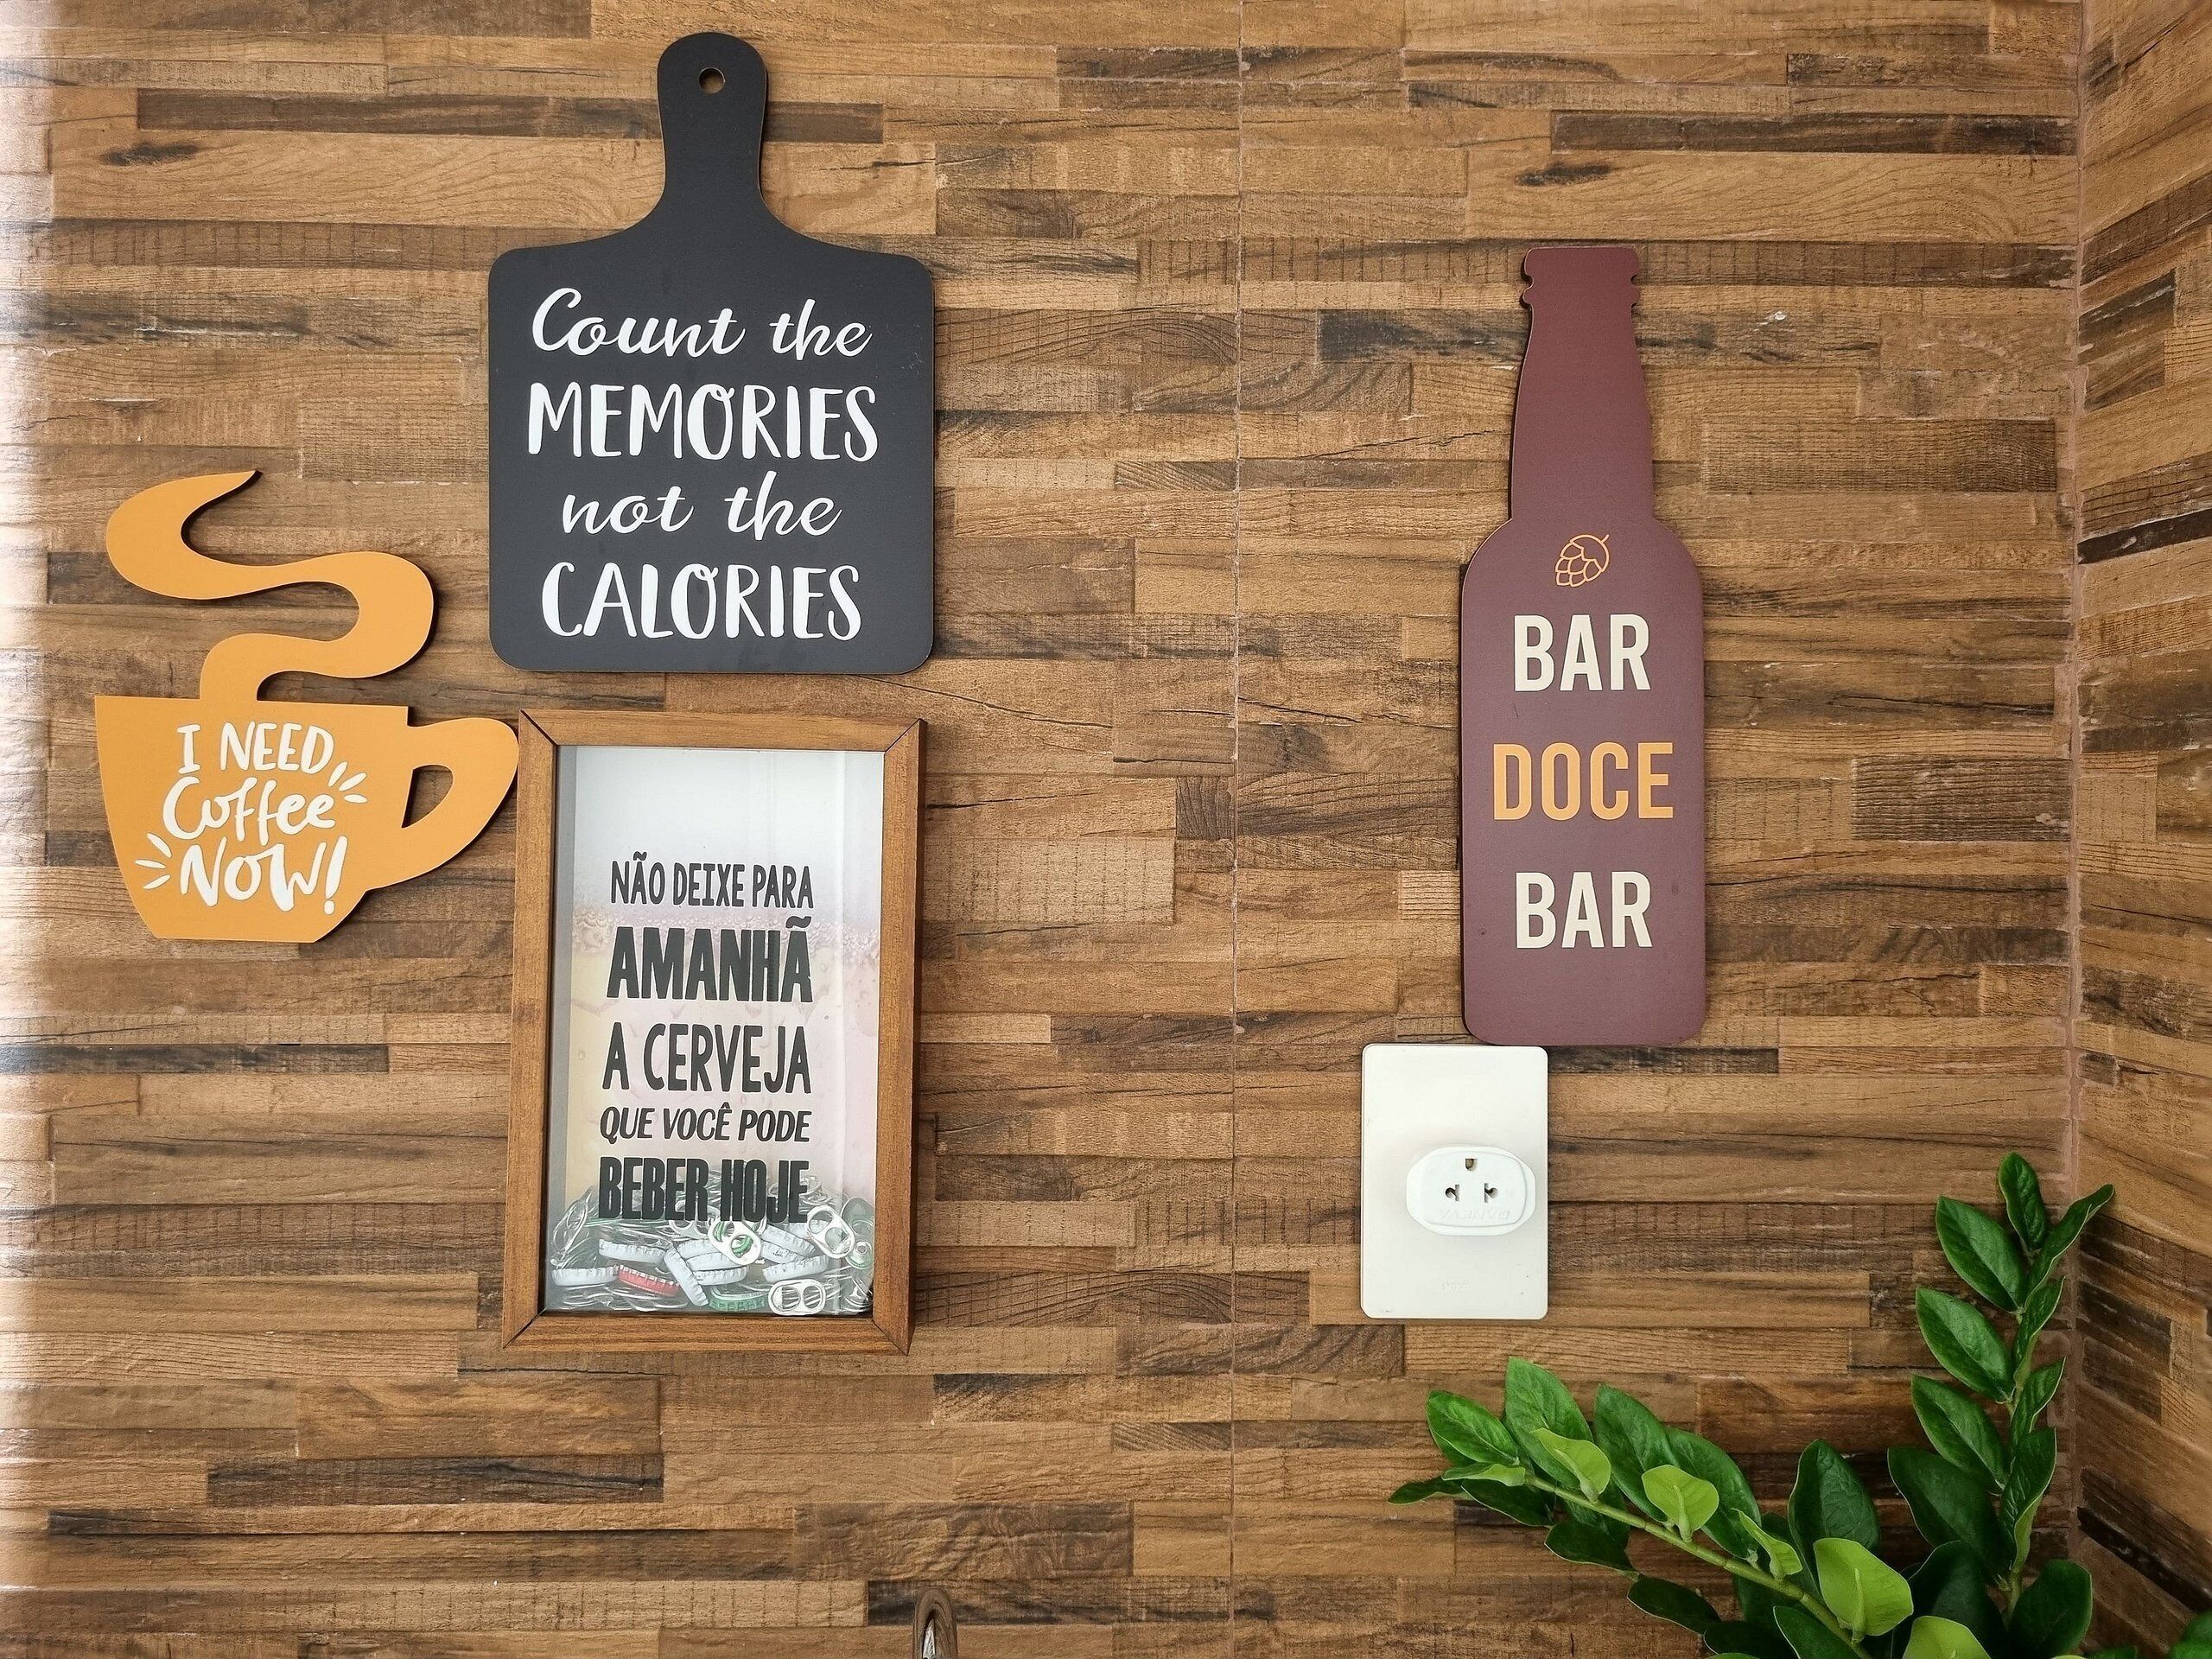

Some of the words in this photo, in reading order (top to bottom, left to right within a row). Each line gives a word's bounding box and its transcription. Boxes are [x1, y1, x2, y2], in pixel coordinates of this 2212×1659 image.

[532, 288, 745, 357] Count
[770, 299, 872, 360] the
[529, 382, 877, 461] MEMORIES
[563, 486, 694, 534] not
[724, 471, 842, 540] the
[543, 563, 861, 640] CALORIES
[1515, 614, 1650, 691] BAR
[177, 725, 200, 773] I
[220, 721, 334, 773] NEED
[1494, 742, 1673, 820] DOCE
[162, 776, 336, 846] Coffee
[180, 836, 348, 915] NOW!
[612, 851, 664, 904] NÃO
[673, 863, 745, 906] DEIXE
[753, 865, 813, 908] PARA
[1516, 872, 1652, 948] BAR
[607, 916, 812, 1002] AMANHÃ
[602, 1022, 629, 1090] A
[644, 1024, 810, 1094] CERVEJA
[600, 1106, 653, 1145] QUE
[663, 1102, 732, 1141] VOCÊ
[739, 1110, 811, 1141] PODE
[599, 1157, 709, 1221] BEBER
[720, 1159, 809, 1223] HOJE
